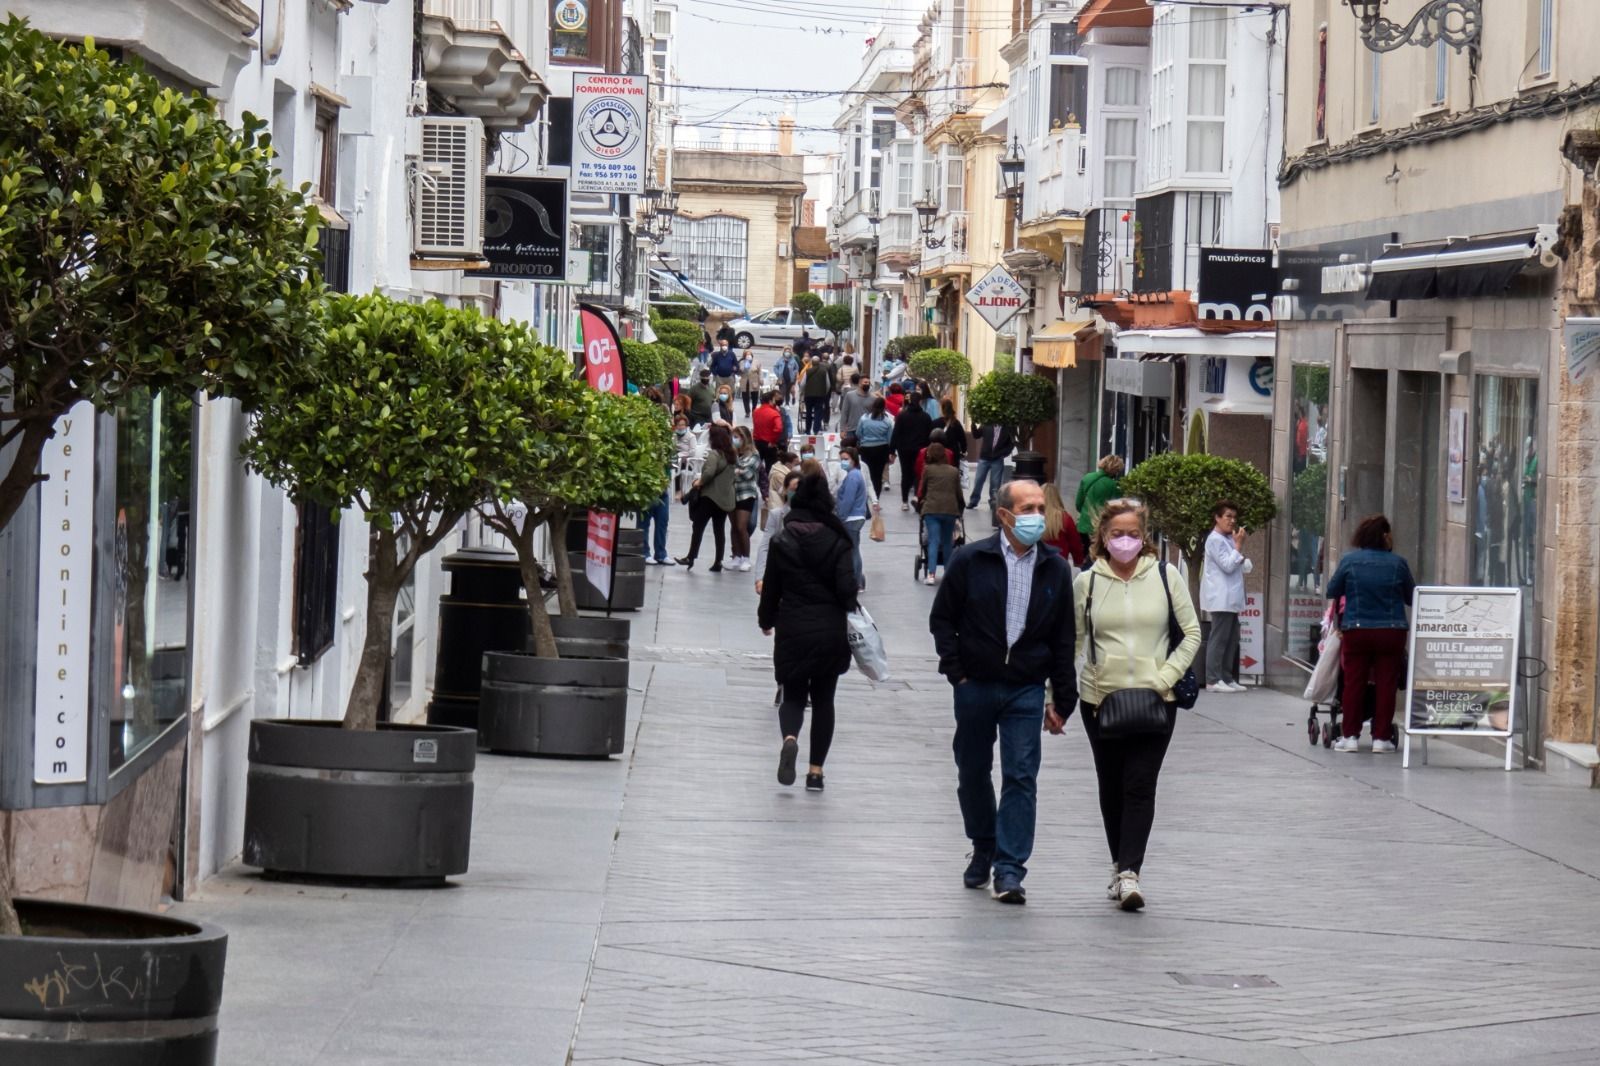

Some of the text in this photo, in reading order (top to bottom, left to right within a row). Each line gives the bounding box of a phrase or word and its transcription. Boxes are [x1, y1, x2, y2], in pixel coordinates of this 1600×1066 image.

[588, 76, 633, 85] CENTRO DE
[627, 87, 645, 96] VIAL
[588, 101, 632, 118] AUTOESCUELA
[595, 146, 622, 155] DIEGO
[53, 418, 73, 774] yeriaonline.com
[1426, 642, 1464, 652] OUTLET
[1426, 690, 1470, 701] Belleza
[1435, 701, 1483, 712] Estética
